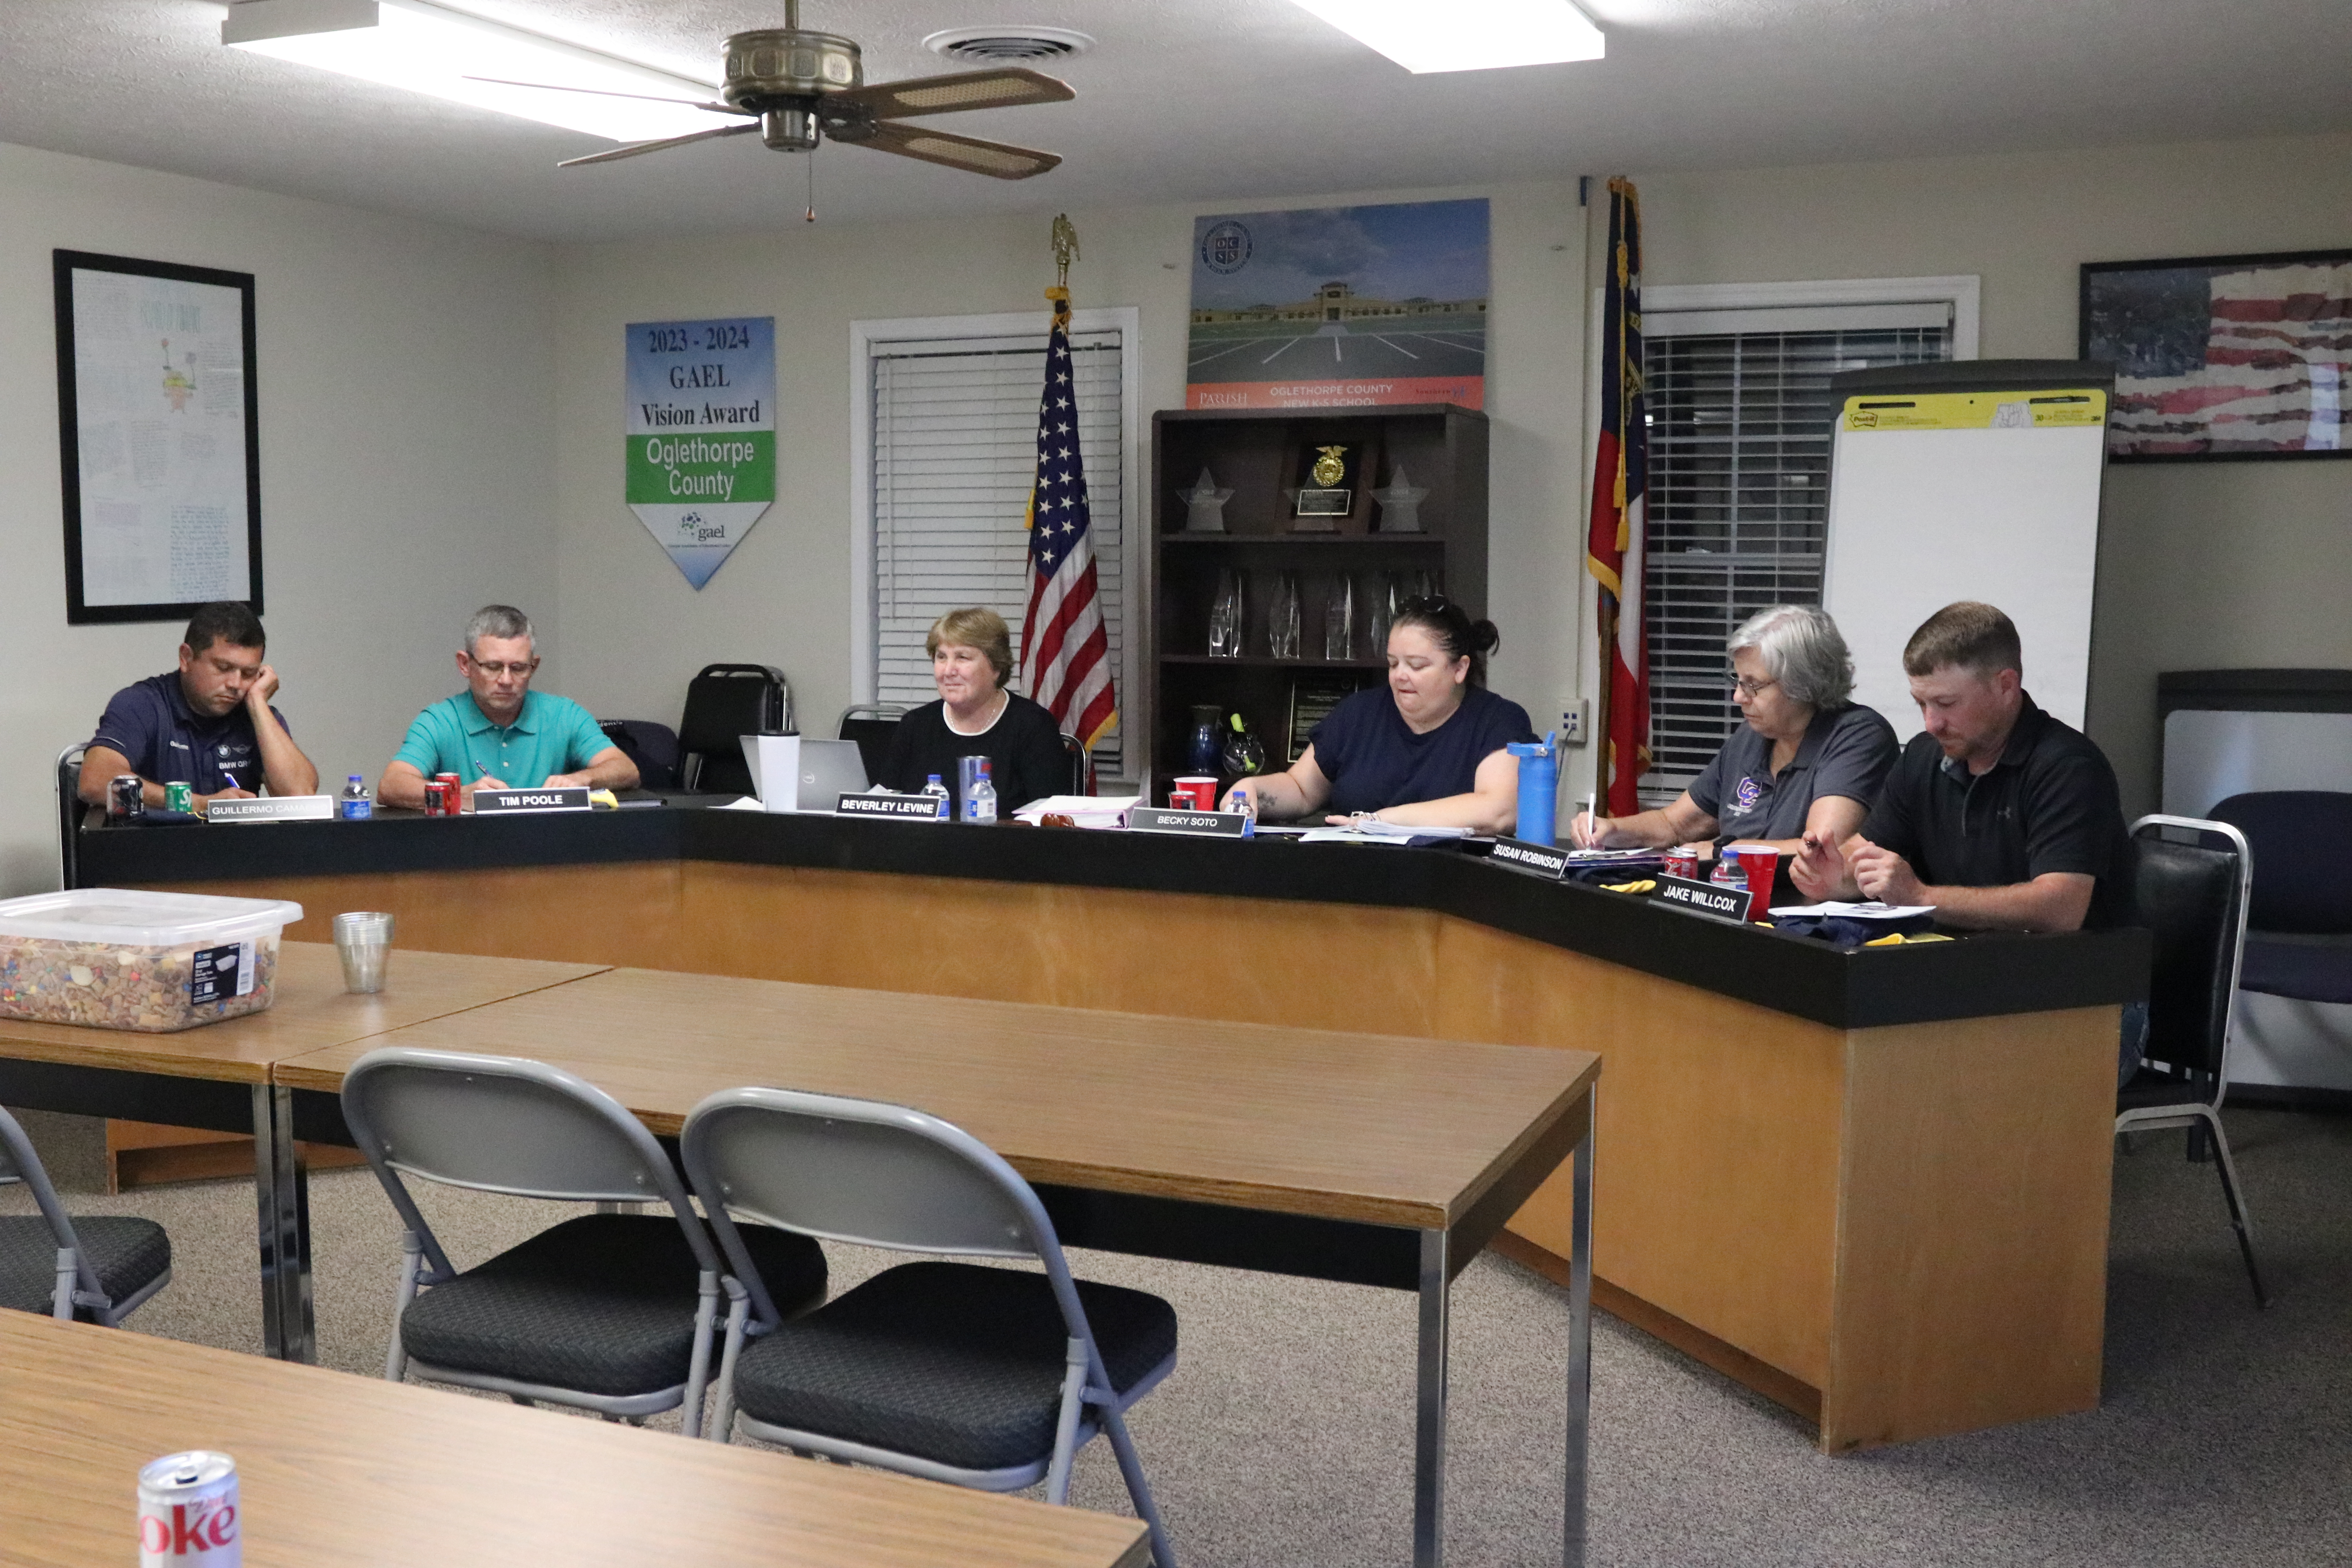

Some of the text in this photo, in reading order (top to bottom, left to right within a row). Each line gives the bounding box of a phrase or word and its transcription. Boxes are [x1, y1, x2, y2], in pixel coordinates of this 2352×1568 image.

[649, 328, 687, 353] 2023
[707, 325, 749, 350] 2024
[670, 364, 730, 389] GAEL
[1270, 384, 1393, 396] OGLETHORPE COUNTY
[641, 399, 760, 426] Vision Award
[1283, 399, 1309, 408] NEW
[1332, 397, 1378, 407] SCHOOL
[647, 437, 754, 470] Oglethorpe
[669, 469, 734, 502] County
[698, 525, 725, 541] gael
[219, 761, 237, 769] BMW
[212, 804, 328, 815] GUILLERMO CAMACHO
[499, 795, 563, 806] TIM POOLE
[841, 799, 935, 814] BEVERLEY LEVINE
[1157, 815, 1218, 827] BECKY SOTO
[1494, 844, 1563, 870] SUSAN ROBINSON
[1663, 884, 1737, 912] JAKE WILLCOX
[140, 1504, 237, 1555] oke
